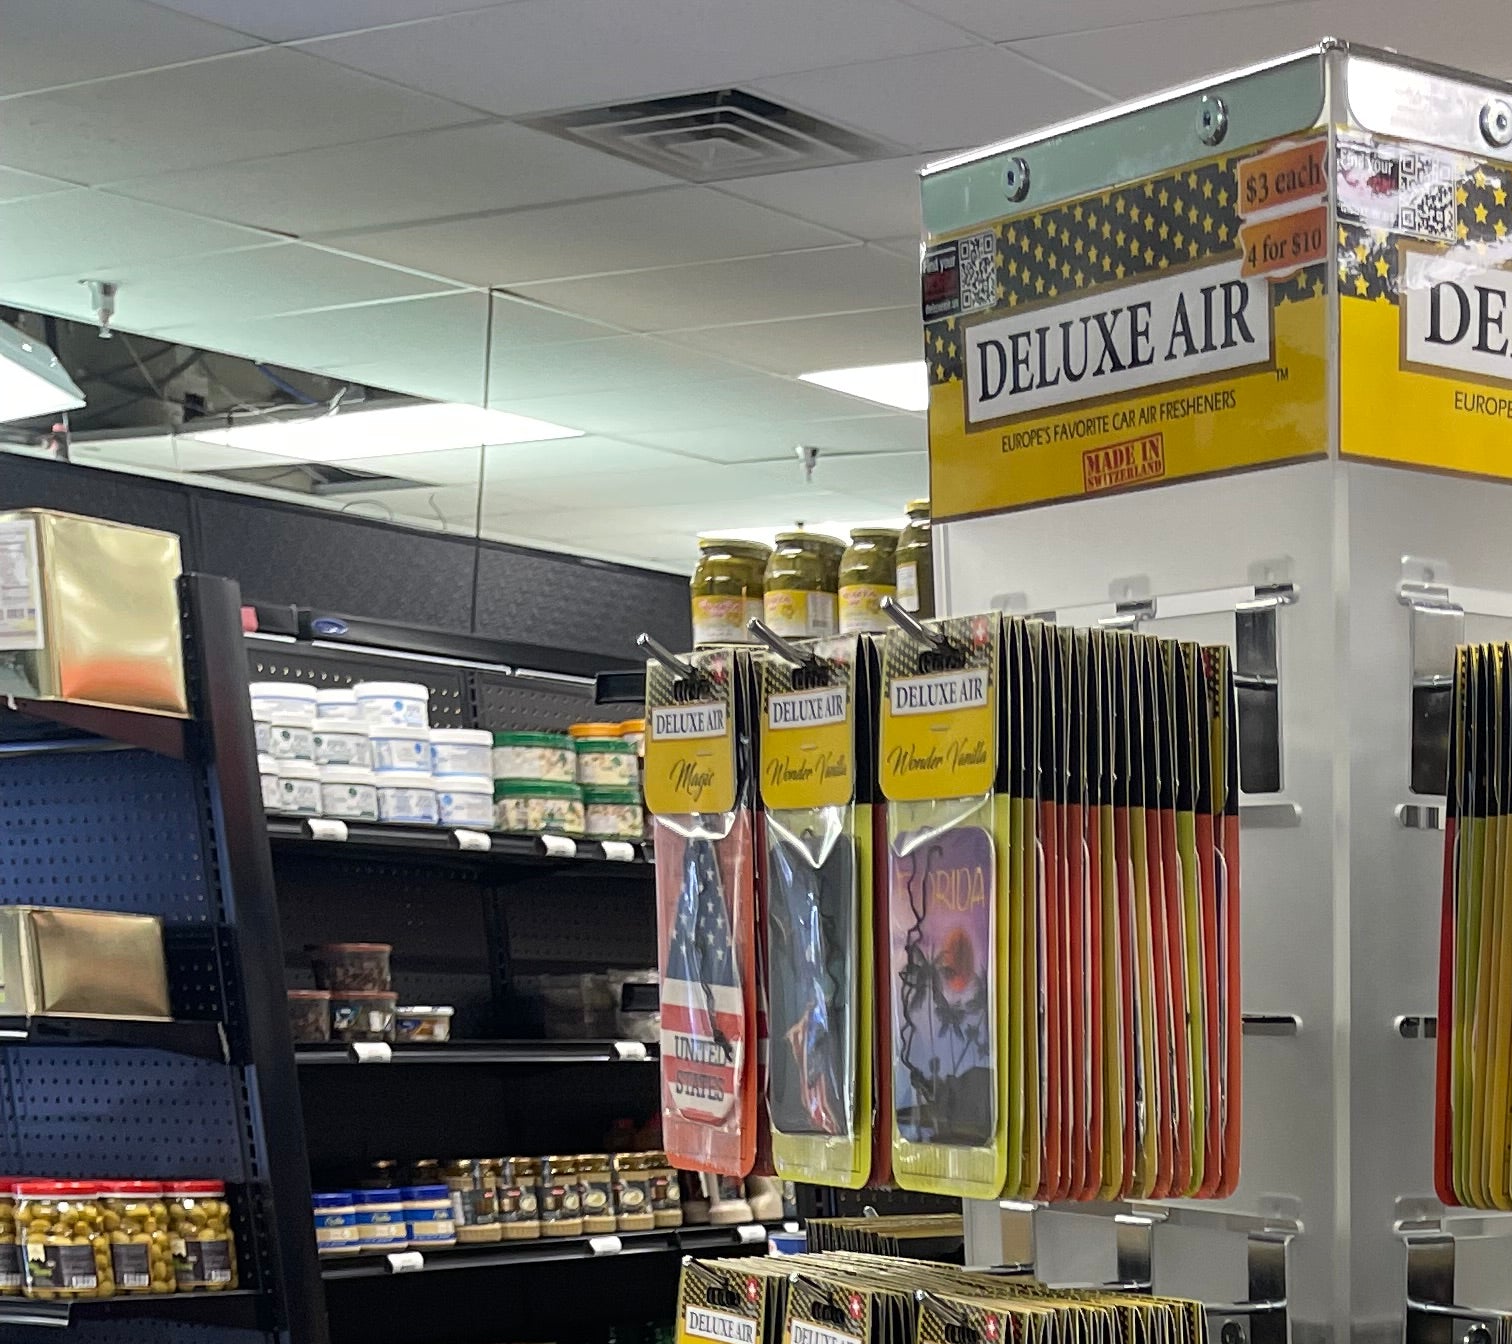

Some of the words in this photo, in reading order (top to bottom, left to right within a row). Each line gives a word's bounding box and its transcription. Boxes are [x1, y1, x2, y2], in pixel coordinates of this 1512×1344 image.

[1246, 178, 1268, 205] $3
[1274, 156, 1323, 196] each
[1248, 244, 1258, 269] 4
[1262, 236, 1286, 264] for
[1292, 227, 1322, 257] $10
[977, 301, 1155, 402] DELUXE
[1165, 280, 1255, 361] AIR
[1002, 425, 1051, 453] EUROPE'S
[1054, 415, 1109, 443] FAVORITE
[1112, 409, 1136, 429] CAR
[1138, 405, 1158, 424] AIR
[1160, 390, 1236, 421] FRESHENERS
[1086, 445, 1135, 476] MADE
[1139, 437, 1160, 460] IN
[1088, 460, 1163, 488] SWITZERLAND
[895, 680, 957, 709] DELUXE
[959, 676, 984, 703] AIR
[655, 709, 703, 736] DELUXE
[706, 707, 725, 732] AIR
[886, 744, 944, 773] Wonder
[946, 736, 987, 769] Vanilla
[670, 757, 715, 802] Magic
